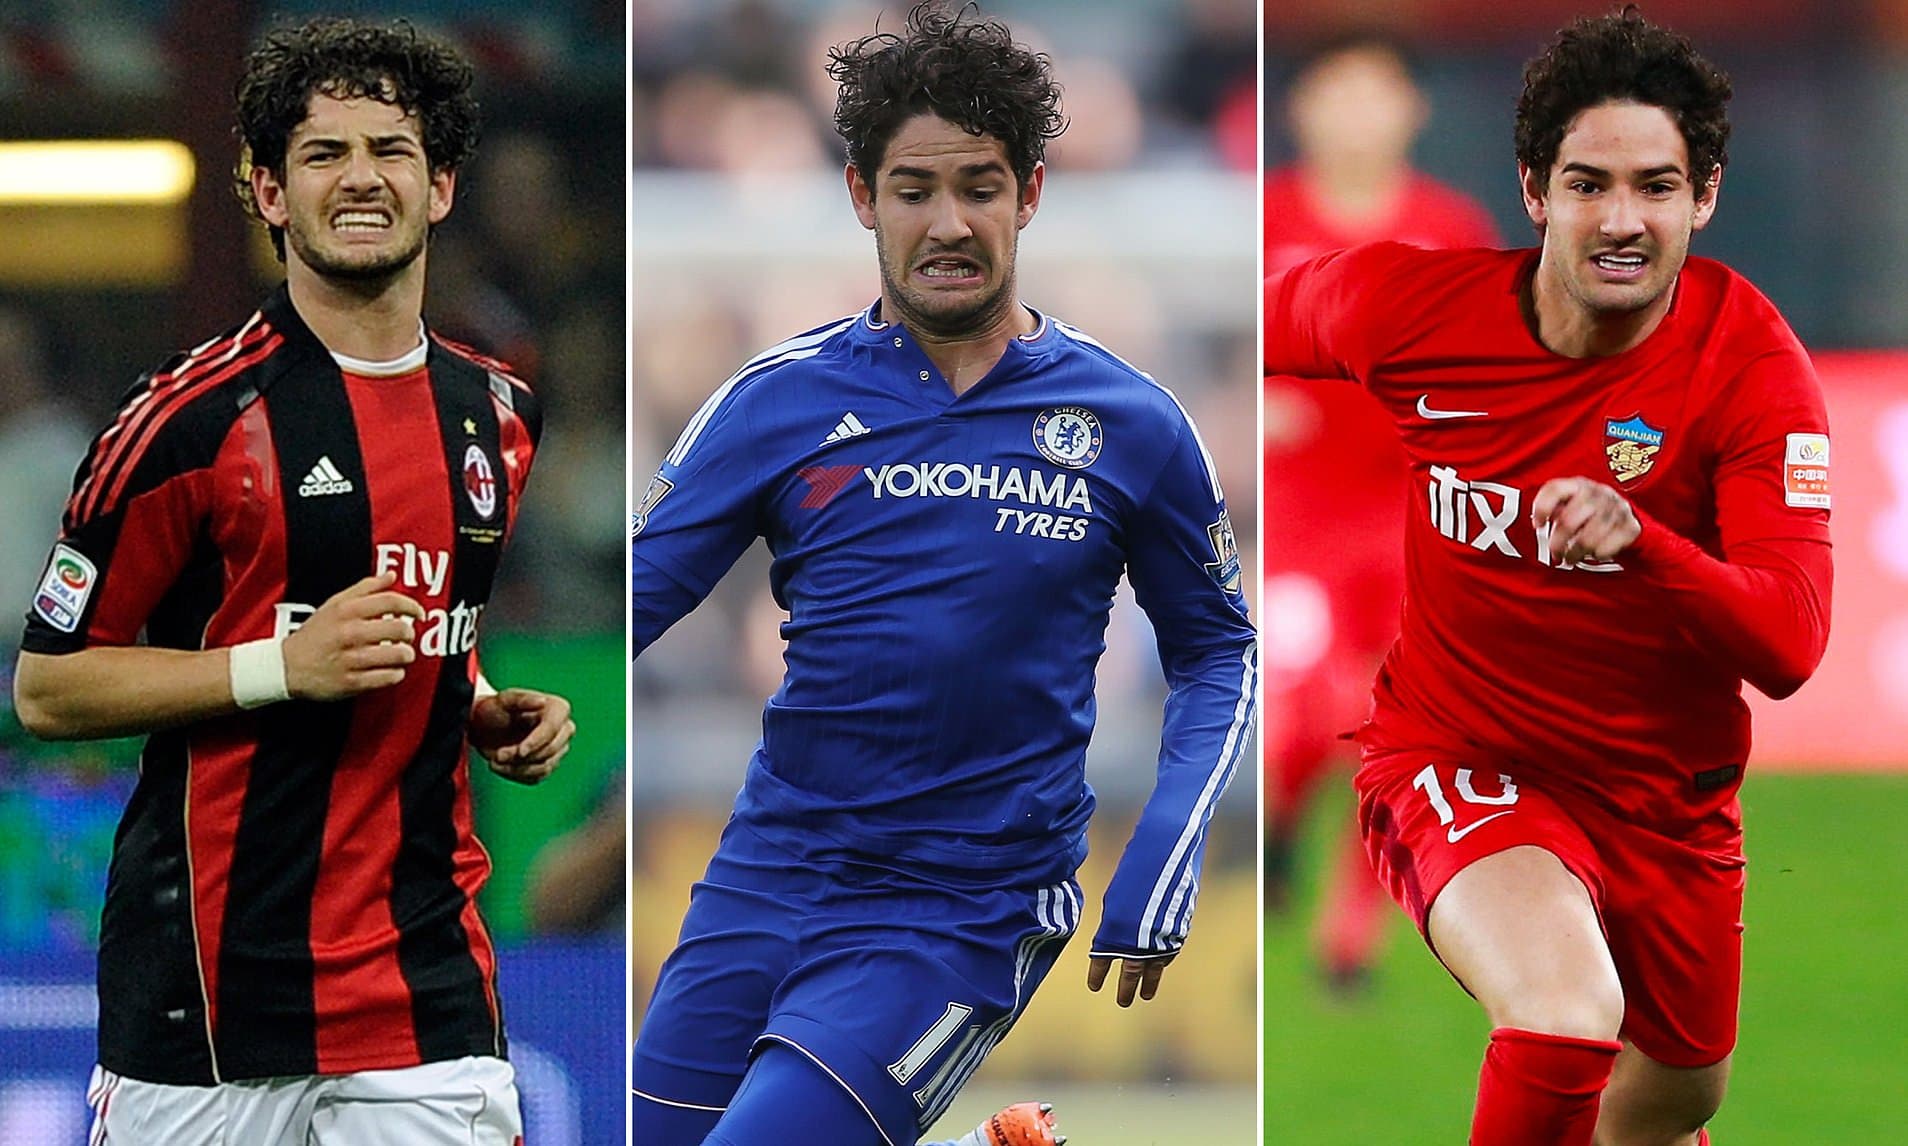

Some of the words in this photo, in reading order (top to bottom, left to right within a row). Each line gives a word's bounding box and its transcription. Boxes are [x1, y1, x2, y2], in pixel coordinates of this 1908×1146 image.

[1054, 407, 1097, 429] CHELSEA
[1608, 425, 1661, 445] QUANJIAN
[299, 480, 353, 497] adidas
[863, 462, 1093, 514] YOKOHAMA
[994, 507, 1090, 542] TYRES
[1428, 464, 1625, 573] 权
[376, 542, 450, 596] Fly
